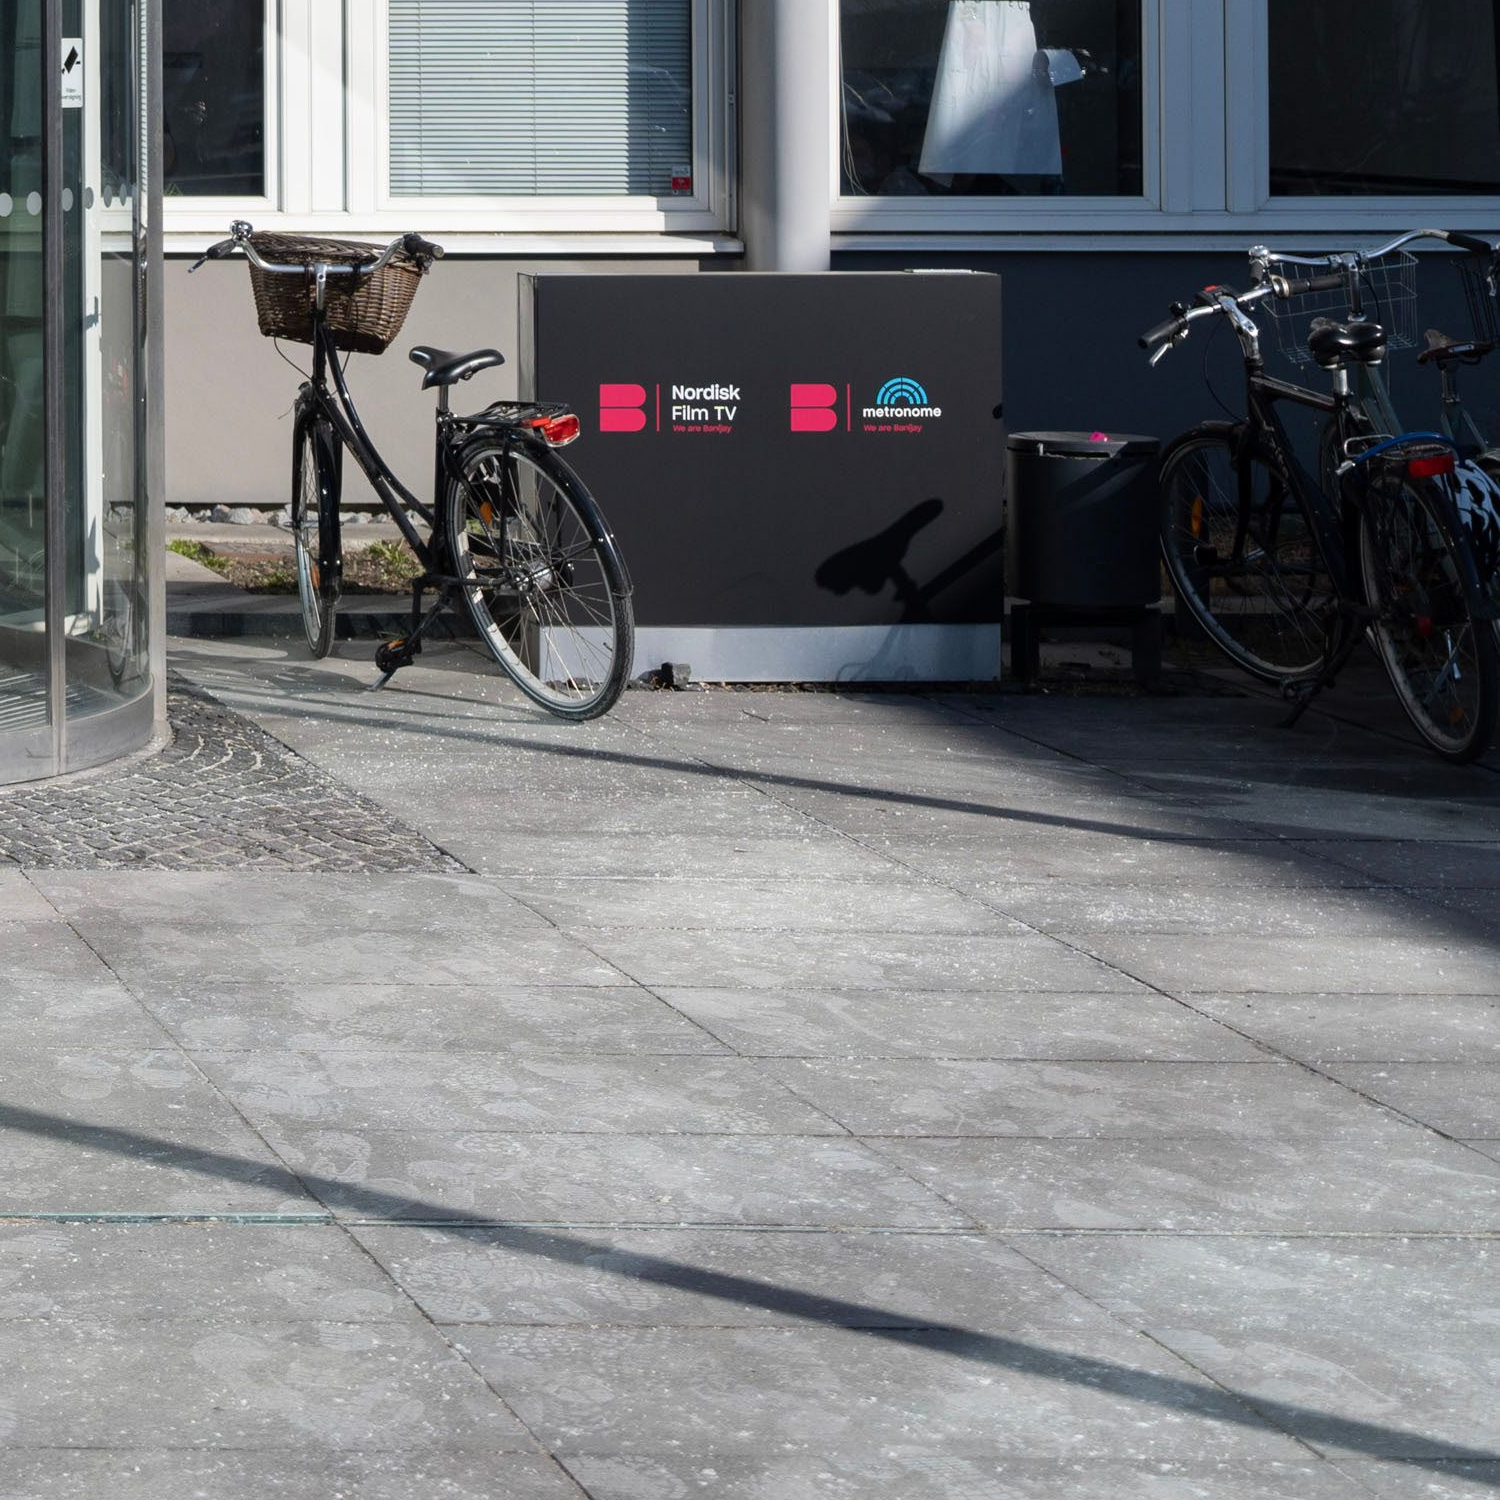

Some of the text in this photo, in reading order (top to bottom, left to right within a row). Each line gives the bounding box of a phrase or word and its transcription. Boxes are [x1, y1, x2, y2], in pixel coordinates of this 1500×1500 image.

[672, 383, 741, 400] Nordisk
[672, 405, 737, 421] Film TV
[862, 406, 942, 418] metronome
[672, 424, 686, 432] We
[863, 424, 877, 432] We
